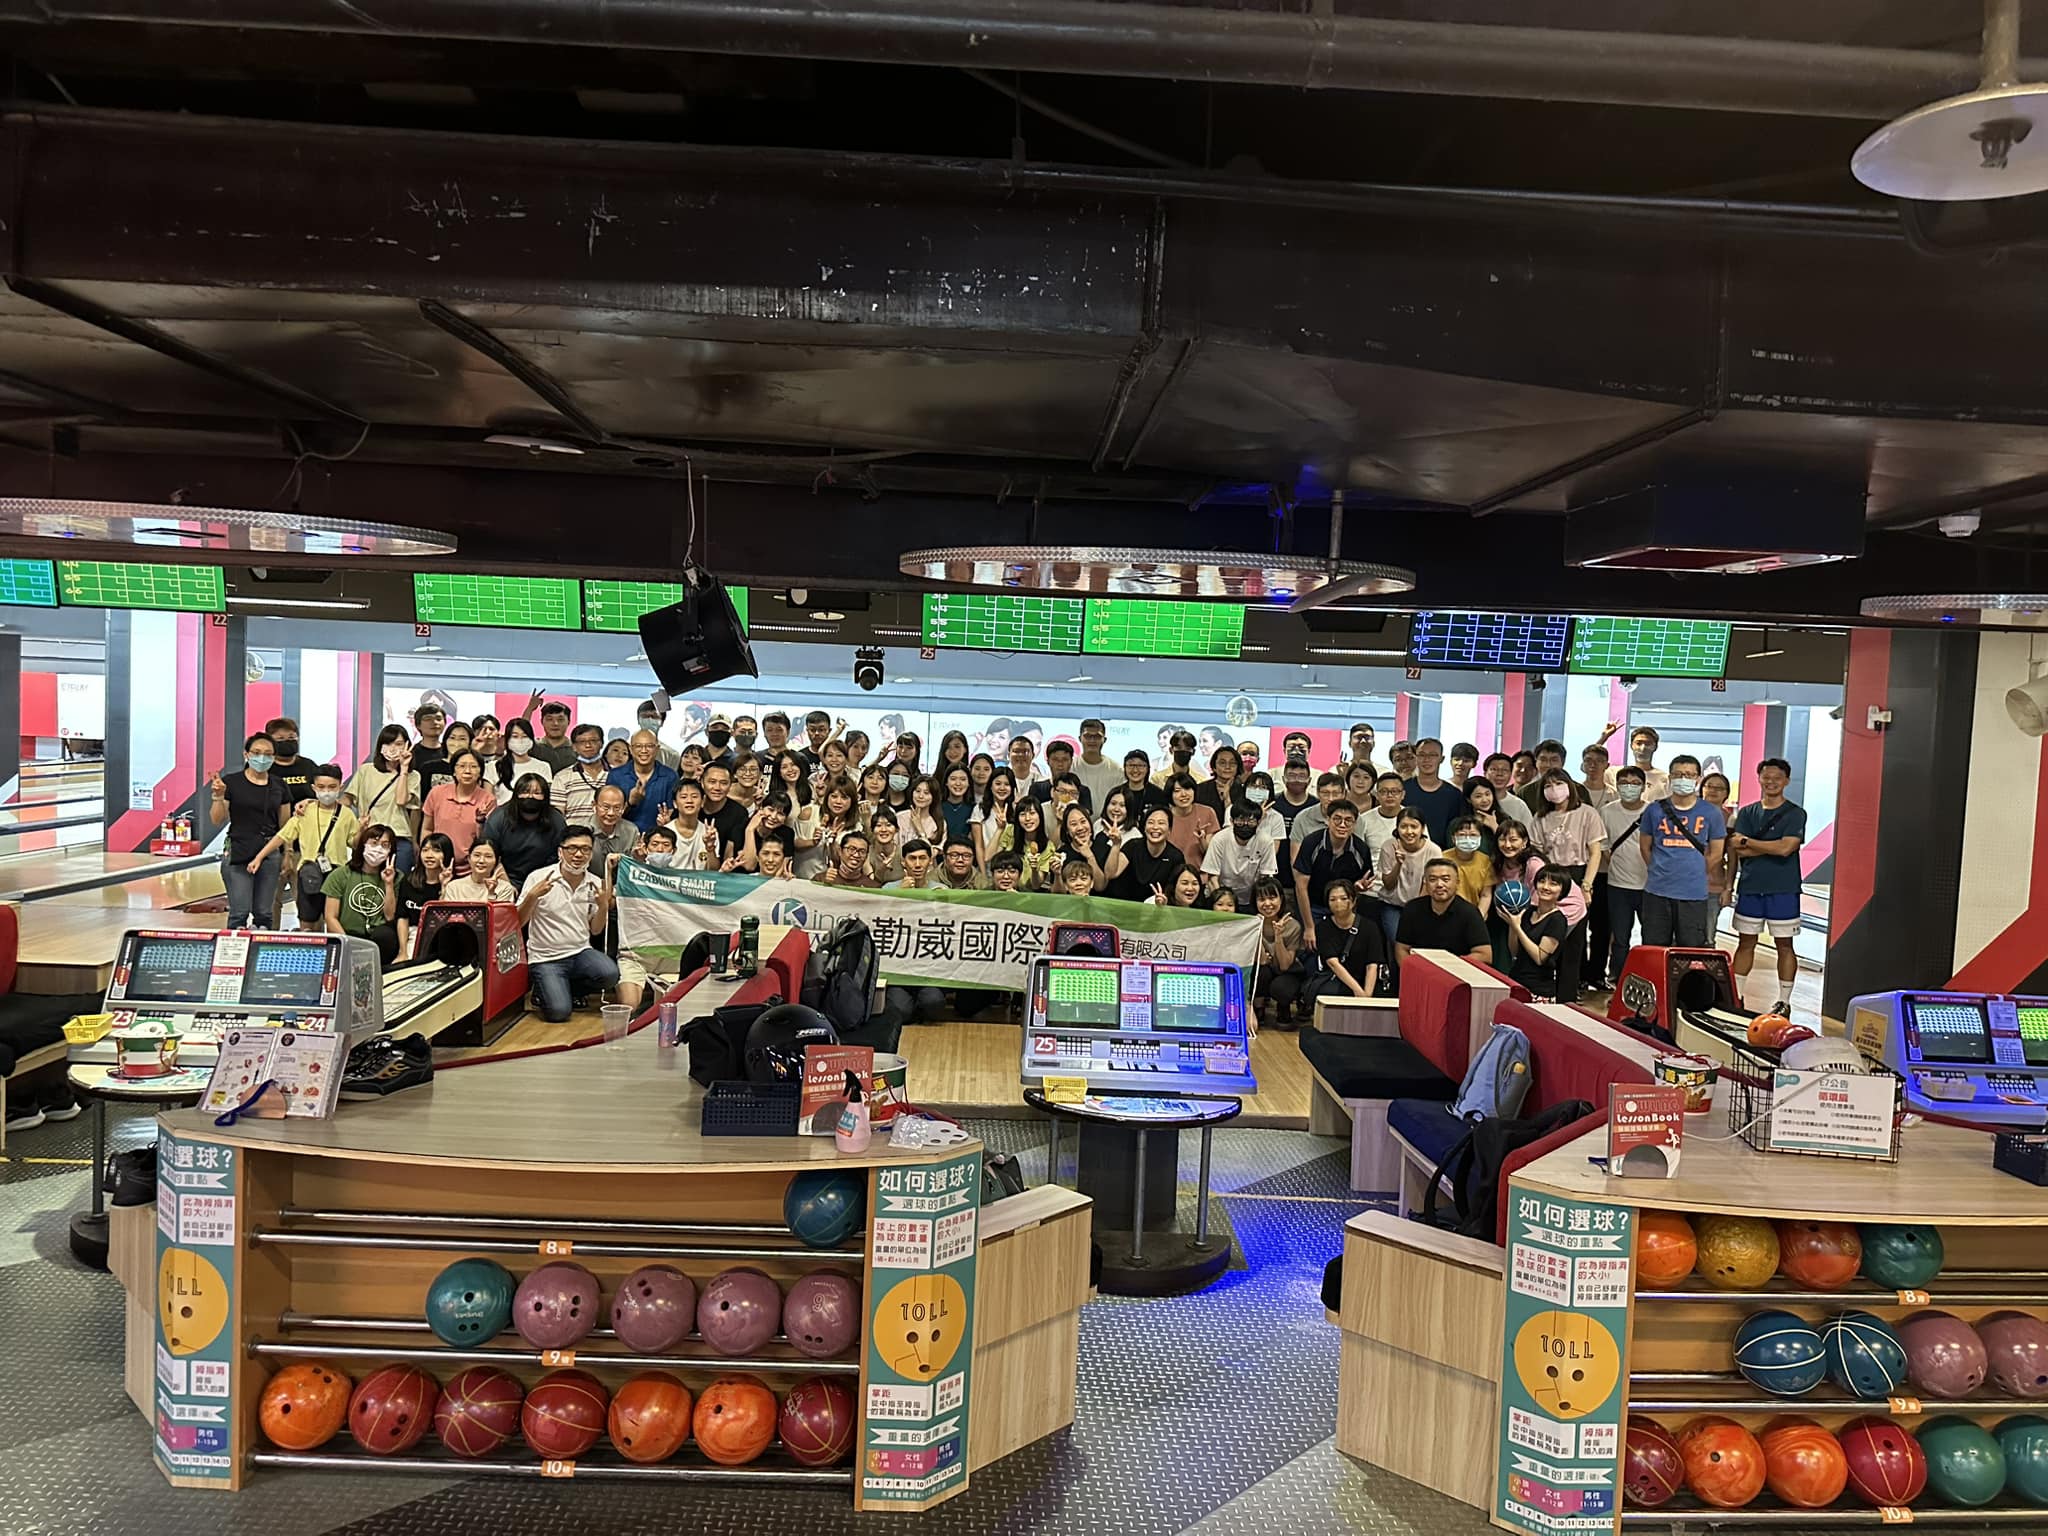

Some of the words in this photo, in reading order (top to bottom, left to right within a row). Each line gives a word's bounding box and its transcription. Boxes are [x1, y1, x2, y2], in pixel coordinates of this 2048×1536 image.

[214, 614, 227, 625] 22
[416, 625, 430, 636] 23
[921, 648, 934, 659] 25
[1407, 668, 1420, 678] 27
[1712, 680, 1725, 690] 28
[632, 868, 679, 889] LEADING
[681, 878, 717, 891] SMART
[681, 888, 716, 900] DRIVING
[870, 916, 1052, 966] 勤崴國際
[113, 1010, 132, 1026] 23
[306, 1017, 326, 1031] 24
[1036, 1037, 1054, 1051] 25
[880, 1163, 975, 1193] 如何選球?
[1519, 1197, 1628, 1231] 如何選球?
[1541, 1229, 1603, 1248] 選球的重點
